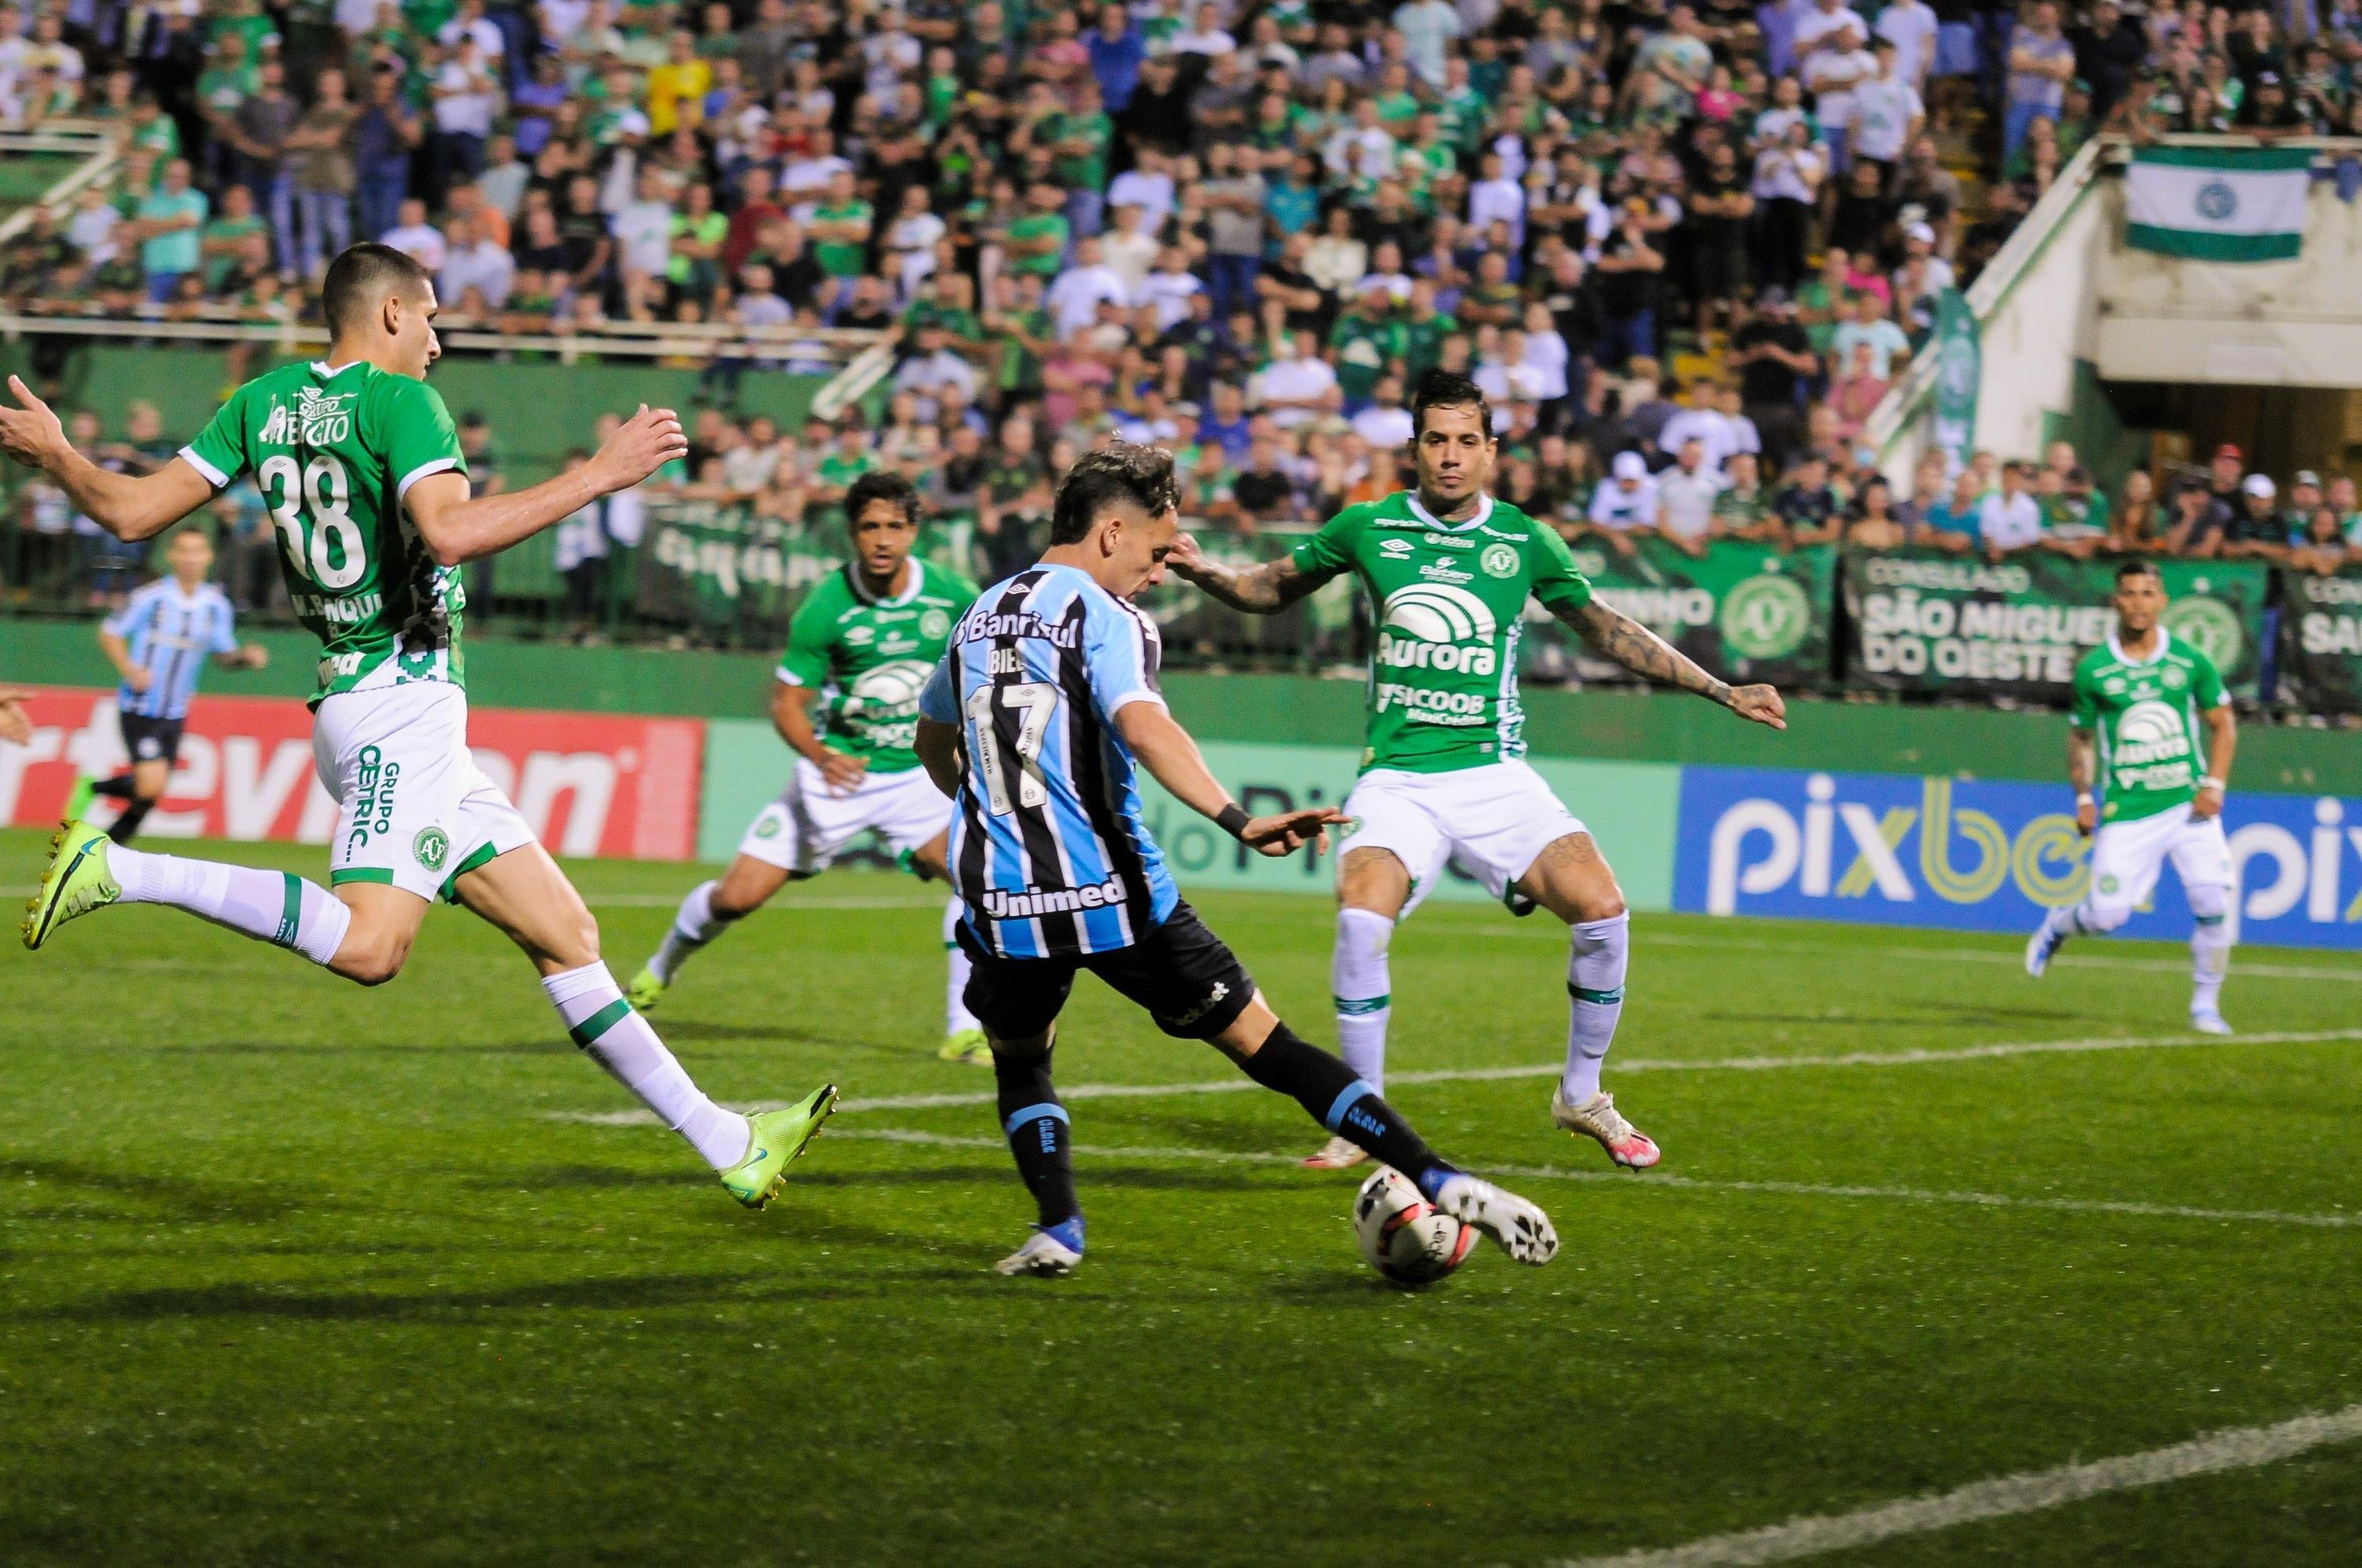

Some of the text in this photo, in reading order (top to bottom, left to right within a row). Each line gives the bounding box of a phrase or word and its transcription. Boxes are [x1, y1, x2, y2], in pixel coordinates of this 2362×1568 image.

[259, 454, 366, 589] 38
[968, 610, 1079, 649] Banrisul
[1862, 587, 1957, 638] SÃO
[2301, 612, 2362, 655] SA
[1375, 631, 1497, 676] Aurora
[1862, 633, 1928, 676] DO
[1934, 637, 2075, 683] OESTE
[1392, 683, 1486, 716] SICOOB
[966, 682, 1058, 817] 17
[348, 744, 382, 850] CETRIC
[374, 761, 400, 835] GRUPO
[1707, 773, 2153, 916] pixbe
[982, 872, 1129, 919] Unimed
[2227, 796, 2362, 945] pi
